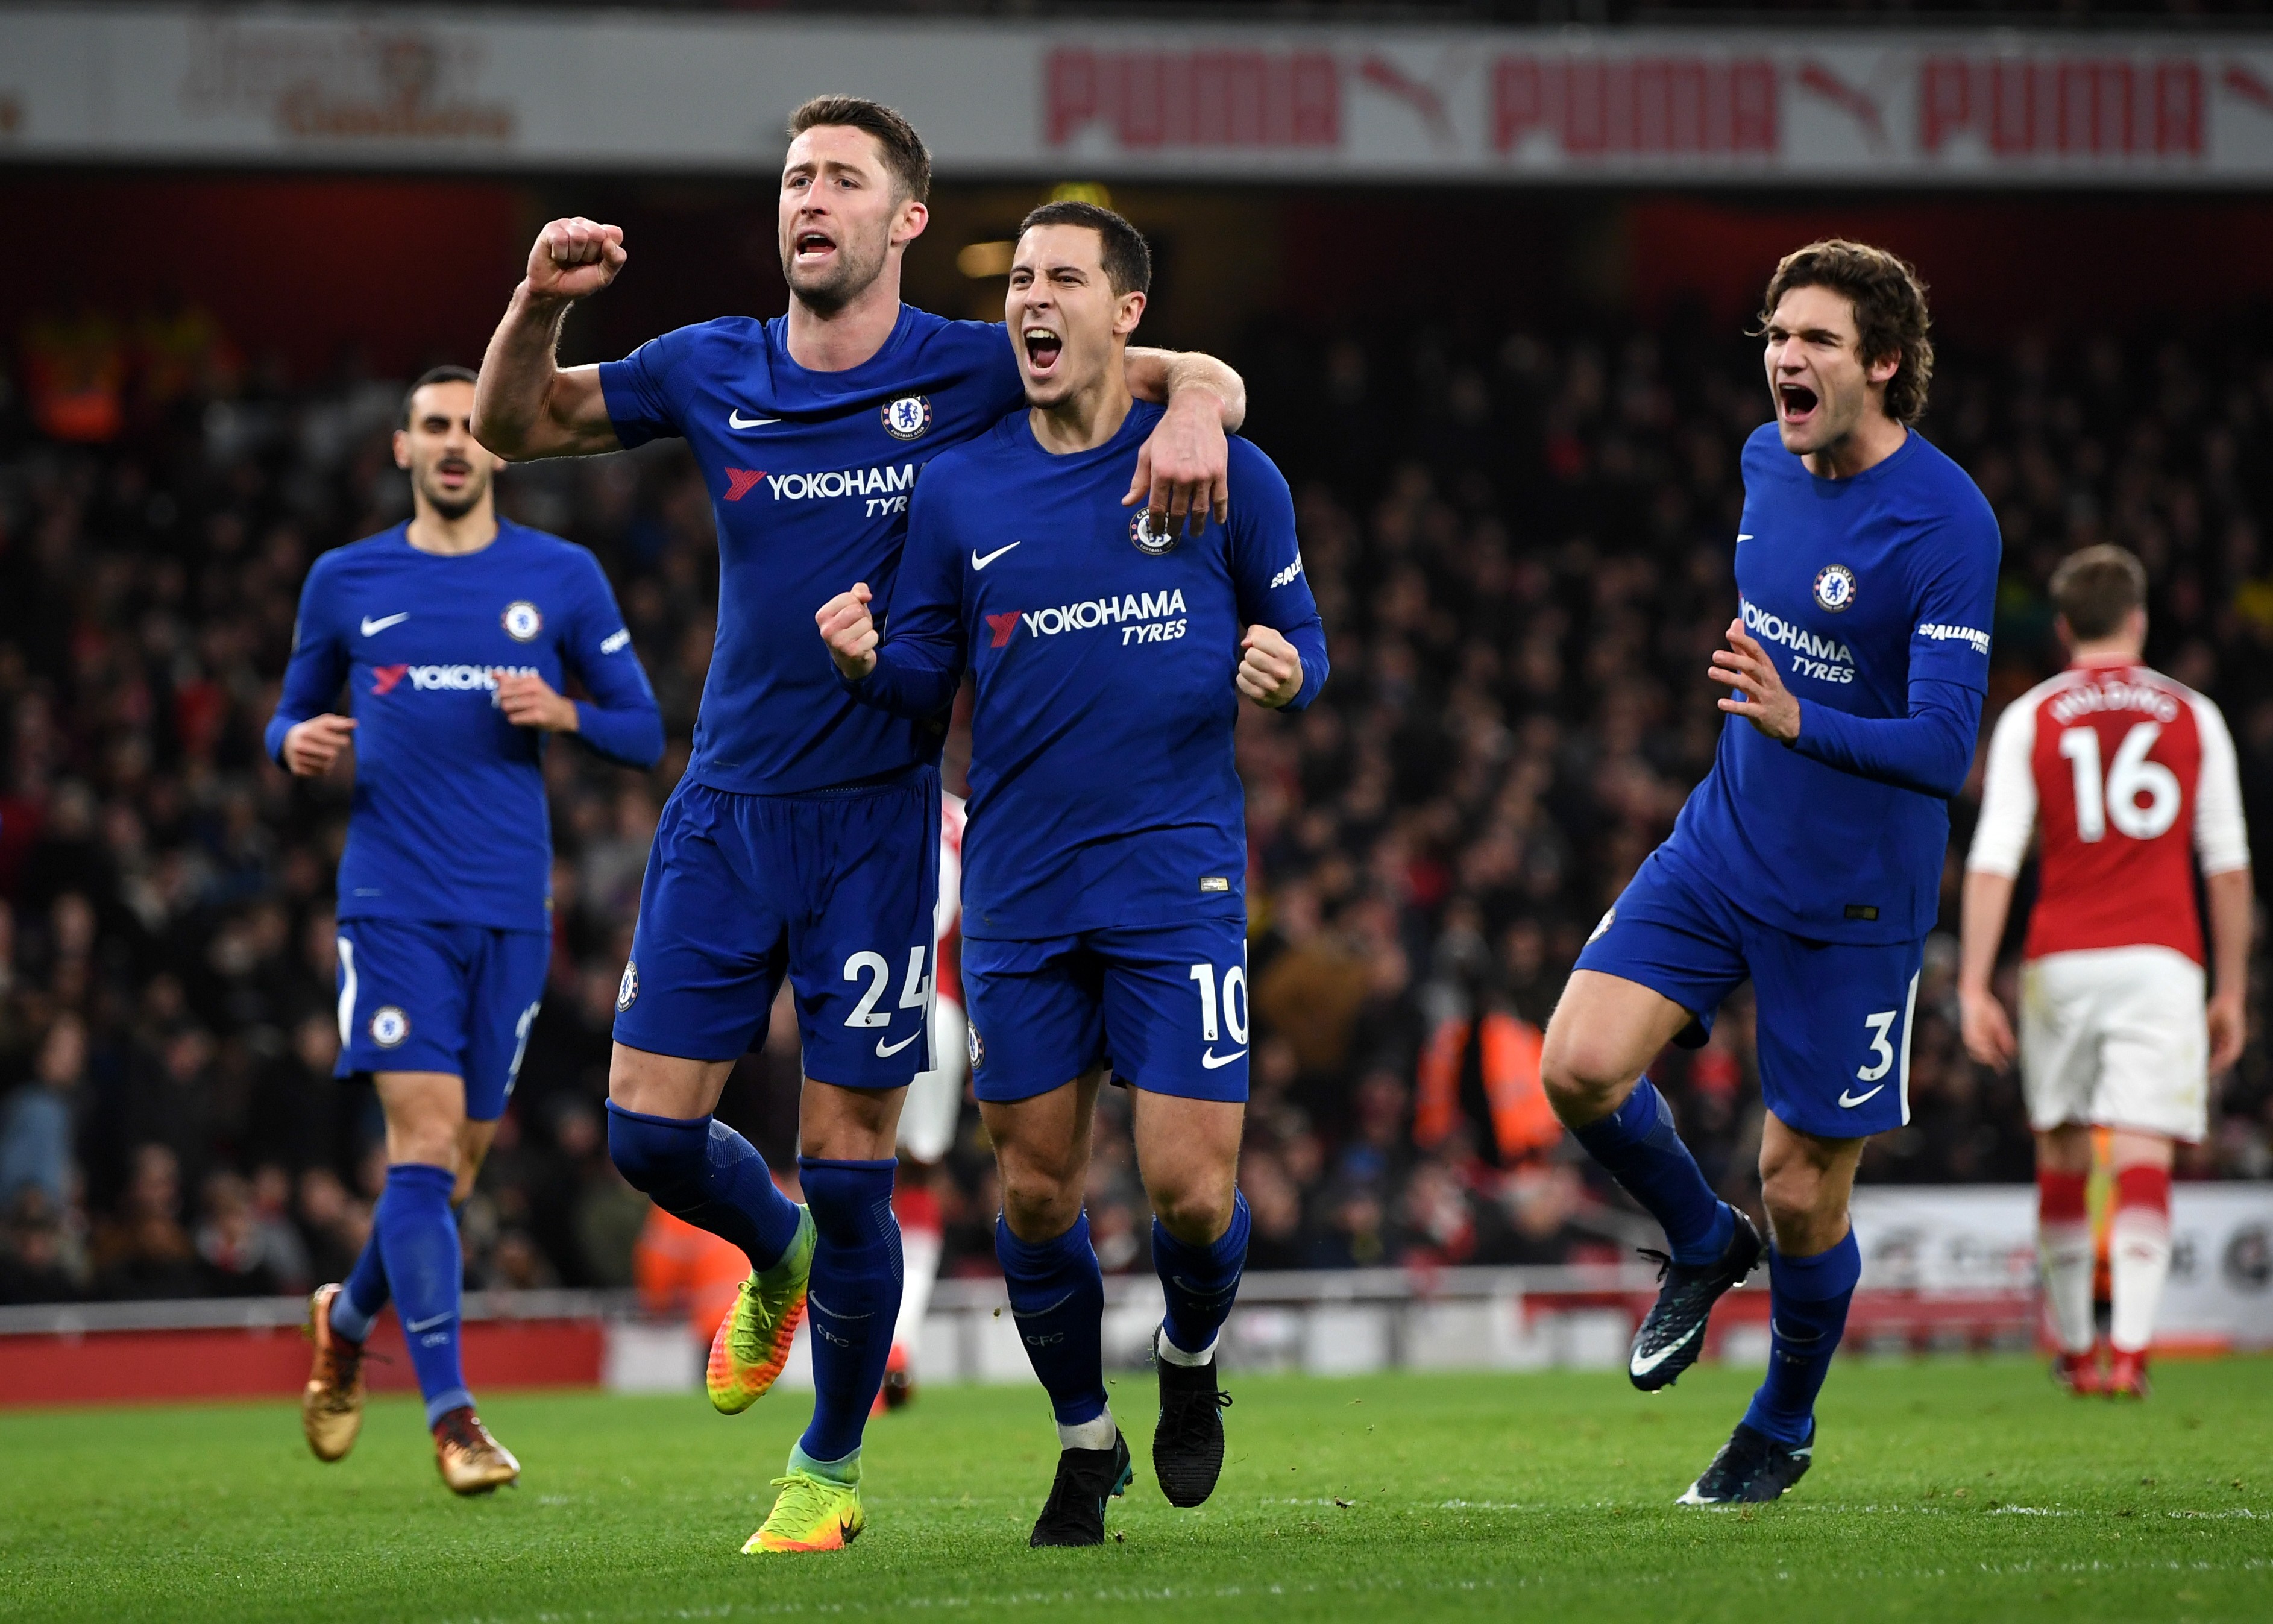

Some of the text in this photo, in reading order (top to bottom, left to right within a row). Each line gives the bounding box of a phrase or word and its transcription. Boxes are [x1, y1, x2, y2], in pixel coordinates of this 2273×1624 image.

[1047, 48, 2206, 157] PUMA PUMA PUMA
[767, 463, 927, 500] YOKOHAM
[866, 496, 908, 517] TYR
[1022, 588, 1186, 638] YOKOHAMA
[1122, 618, 1187, 646] TYRES
[1740, 597, 1855, 666] YOKOHAMA
[1791, 655, 1855, 684] TYRES
[2058, 721, 2182, 843] 16
[843, 945, 929, 1028] 24
[1190, 963, 1248, 1045] 10
[1856, 1010, 1897, 1081] 3
[817, 1324, 849, 1347] CFC
[1026, 1332, 1063, 1347] CFC
